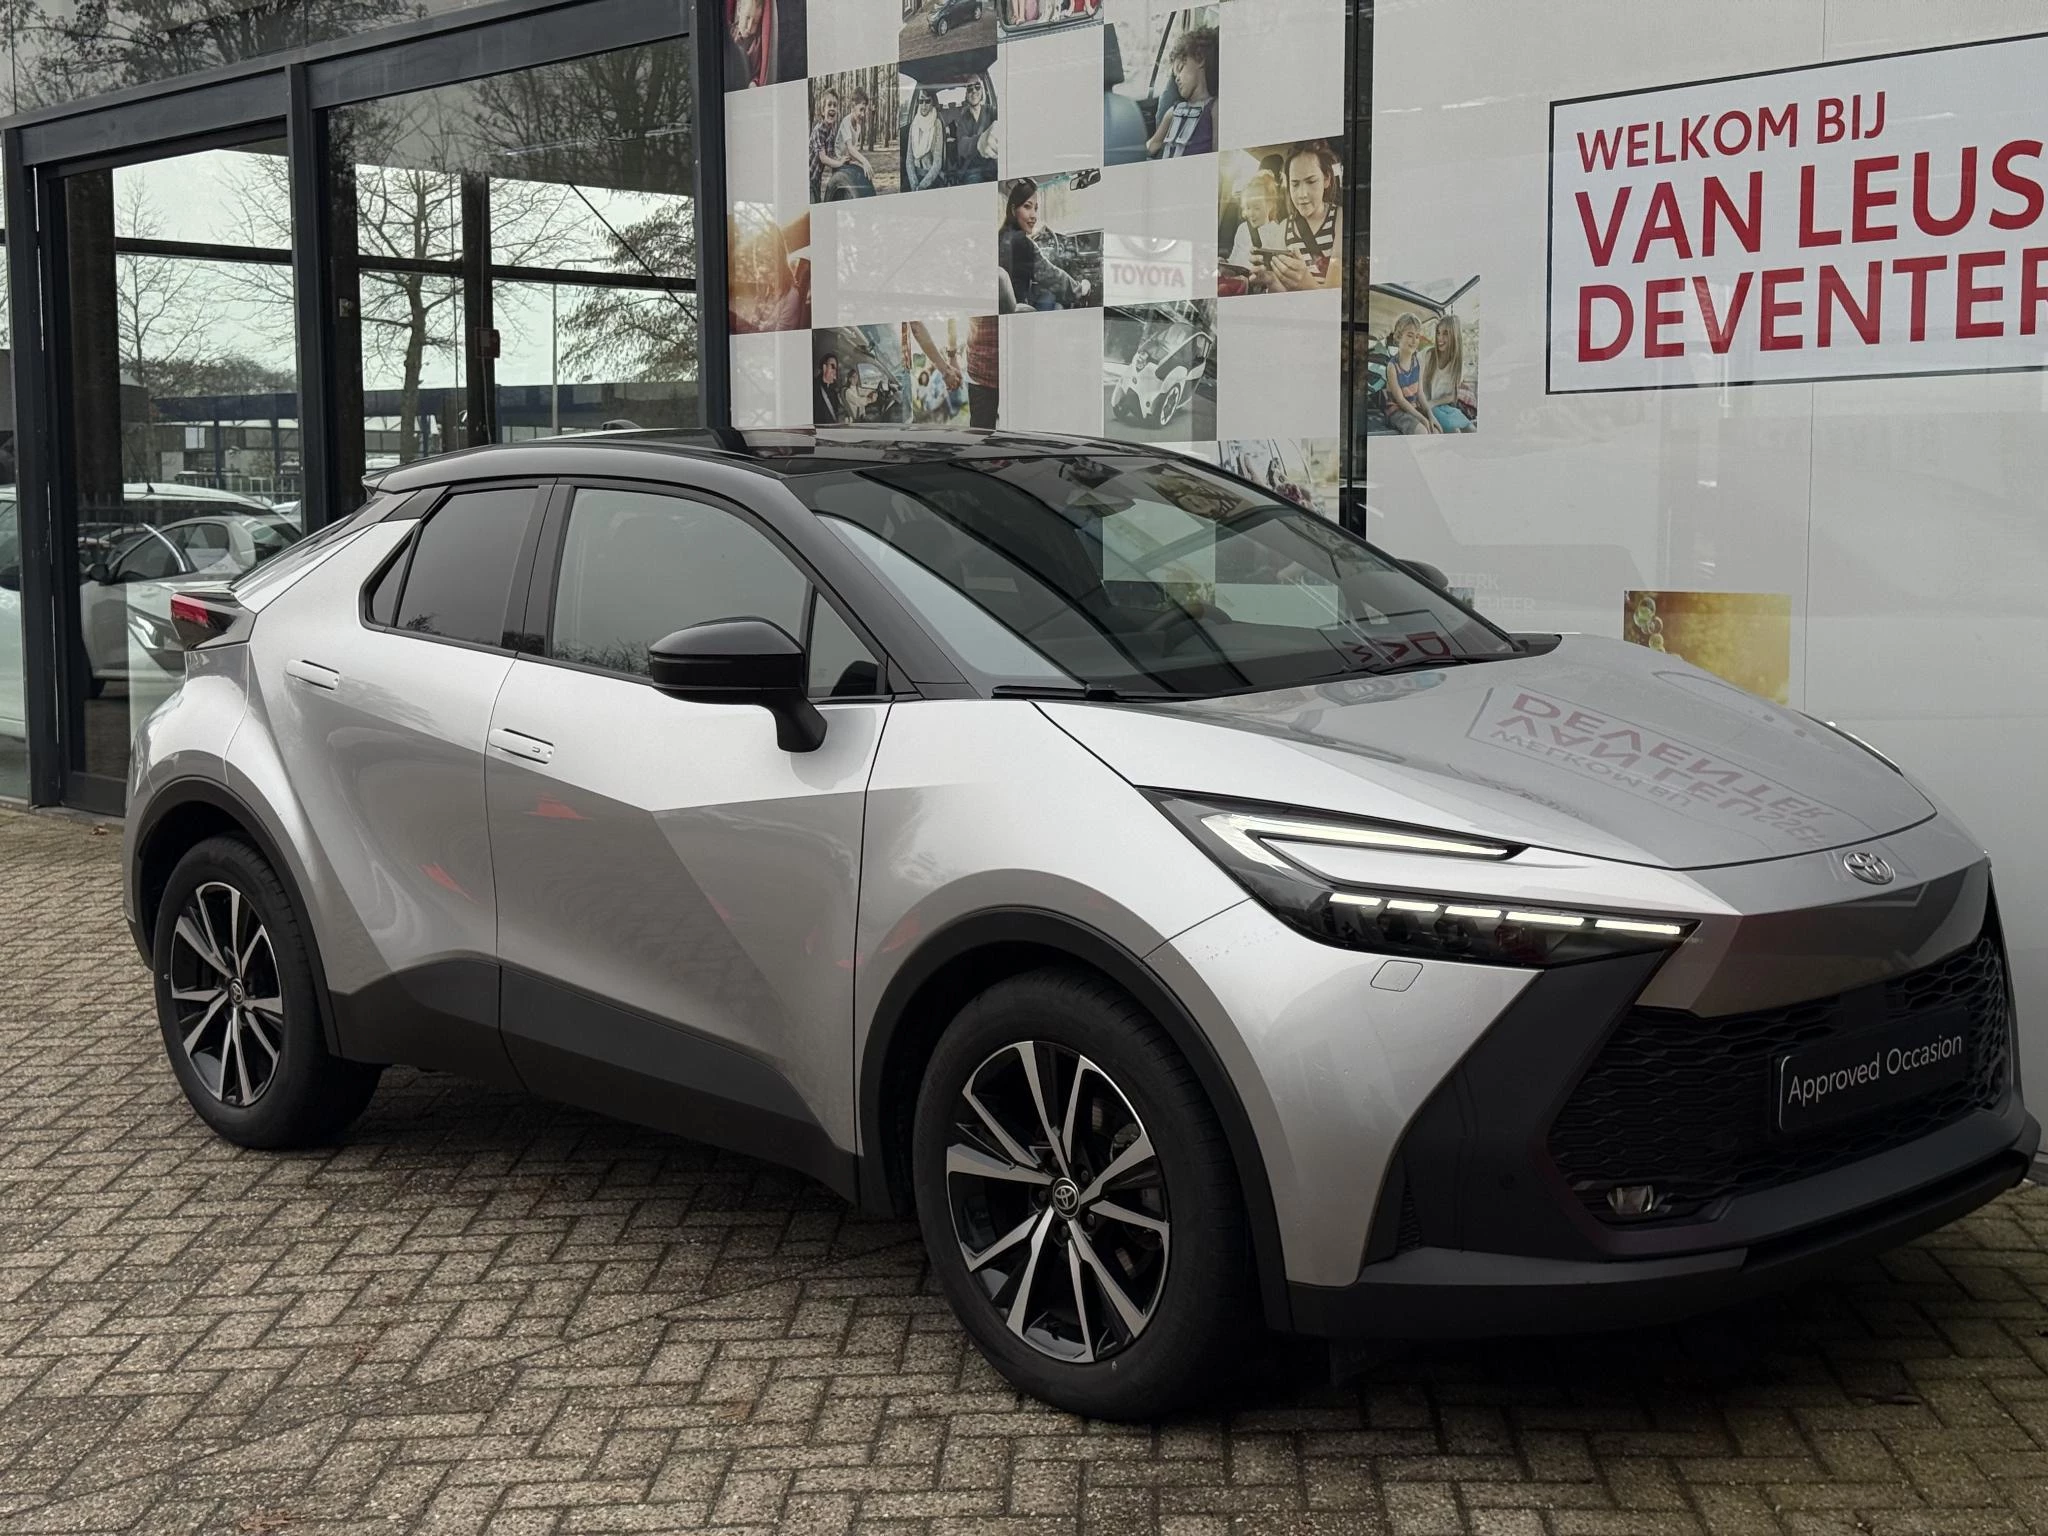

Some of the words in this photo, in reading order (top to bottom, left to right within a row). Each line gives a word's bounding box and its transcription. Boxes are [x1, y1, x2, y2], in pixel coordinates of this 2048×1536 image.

[1577, 102, 1798, 173] WELKOM
[1817, 91, 1885, 144] BIJ
[1575, 170, 1763, 267] VAN
[1799, 139, 2044, 248] LEUS
[1110, 264, 1186, 288] TOYOTA
[1578, 247, 2048, 362] DEVENTER
[1788, 1052, 1880, 1107] Approved
[1887, 1035, 1962, 1074] Occasion
